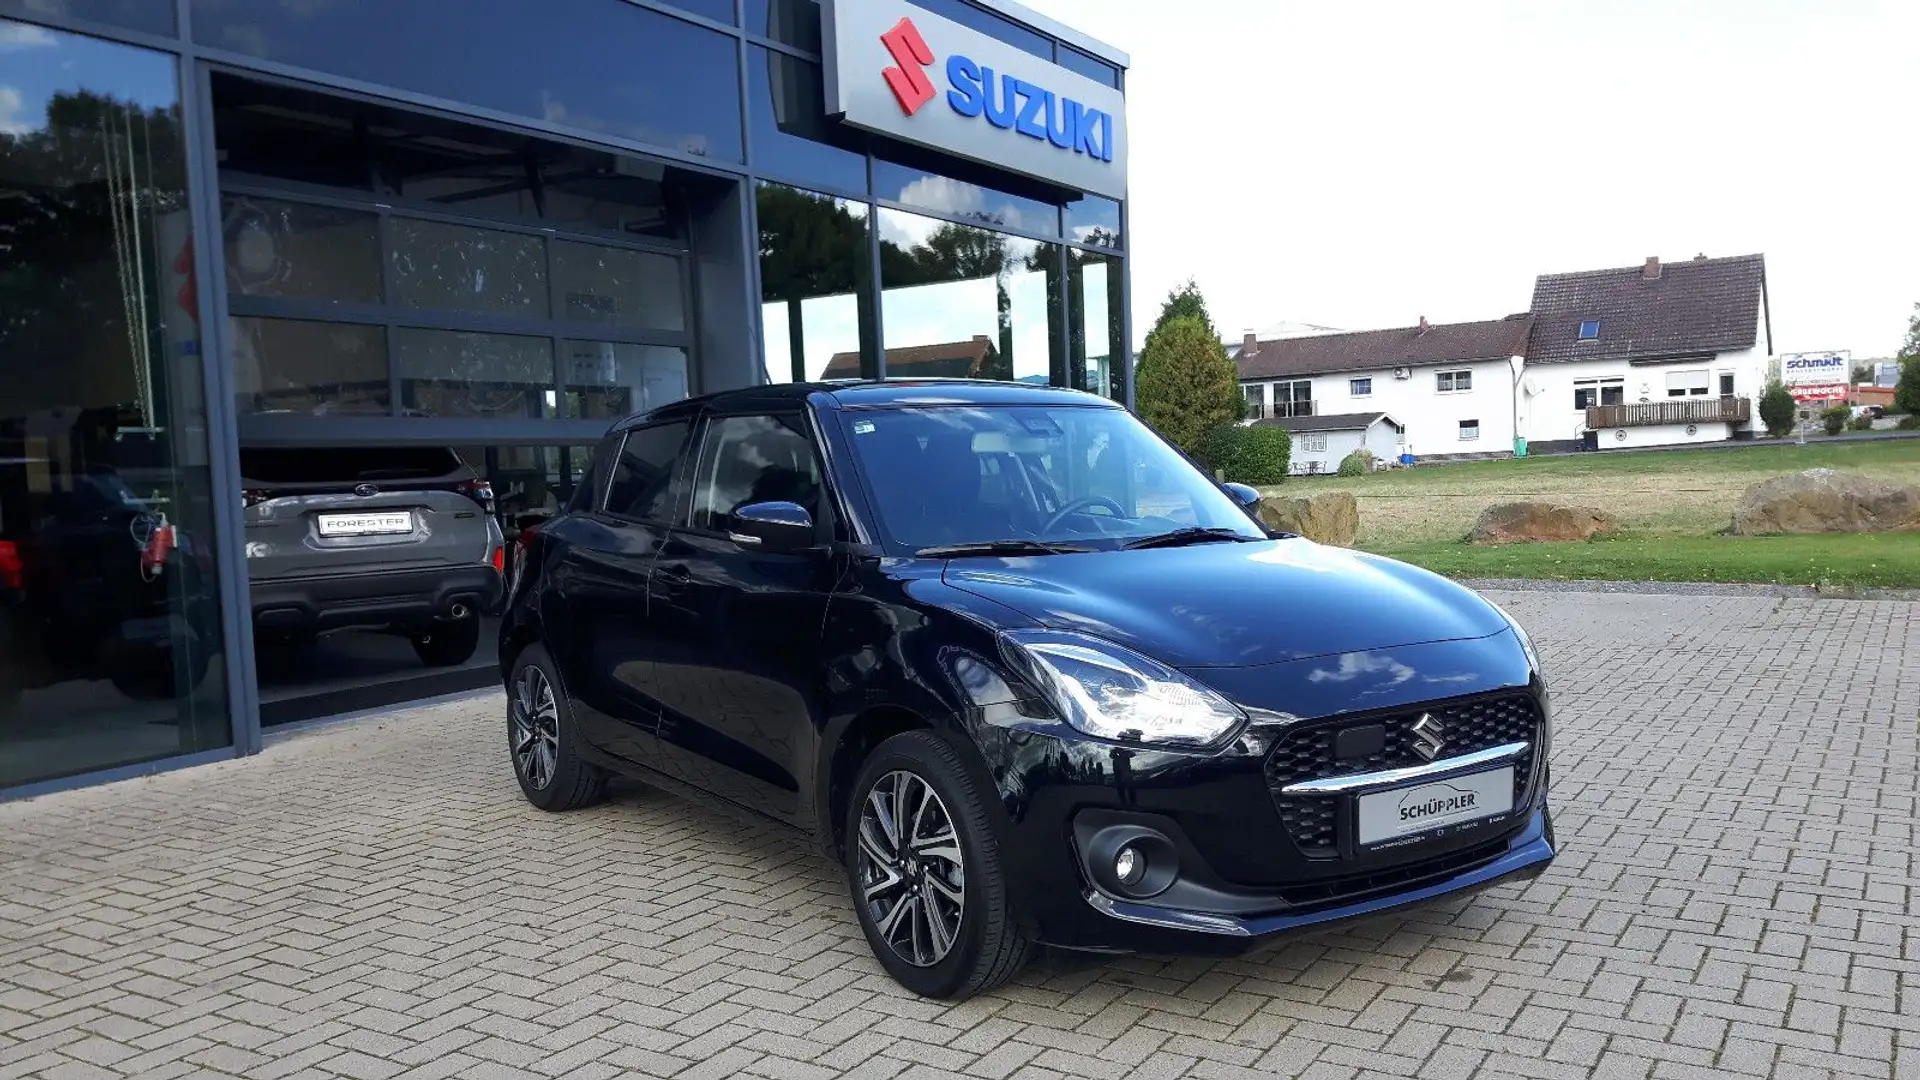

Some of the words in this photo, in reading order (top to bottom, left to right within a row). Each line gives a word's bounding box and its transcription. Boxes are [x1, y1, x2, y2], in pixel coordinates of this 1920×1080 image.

[946, 54, 1112, 163] SUZUKI
[1786, 357, 1844, 370] schmidt
[327, 518, 404, 529] FORESTER
[1400, 793, 1476, 820] SCHÜPPLER
